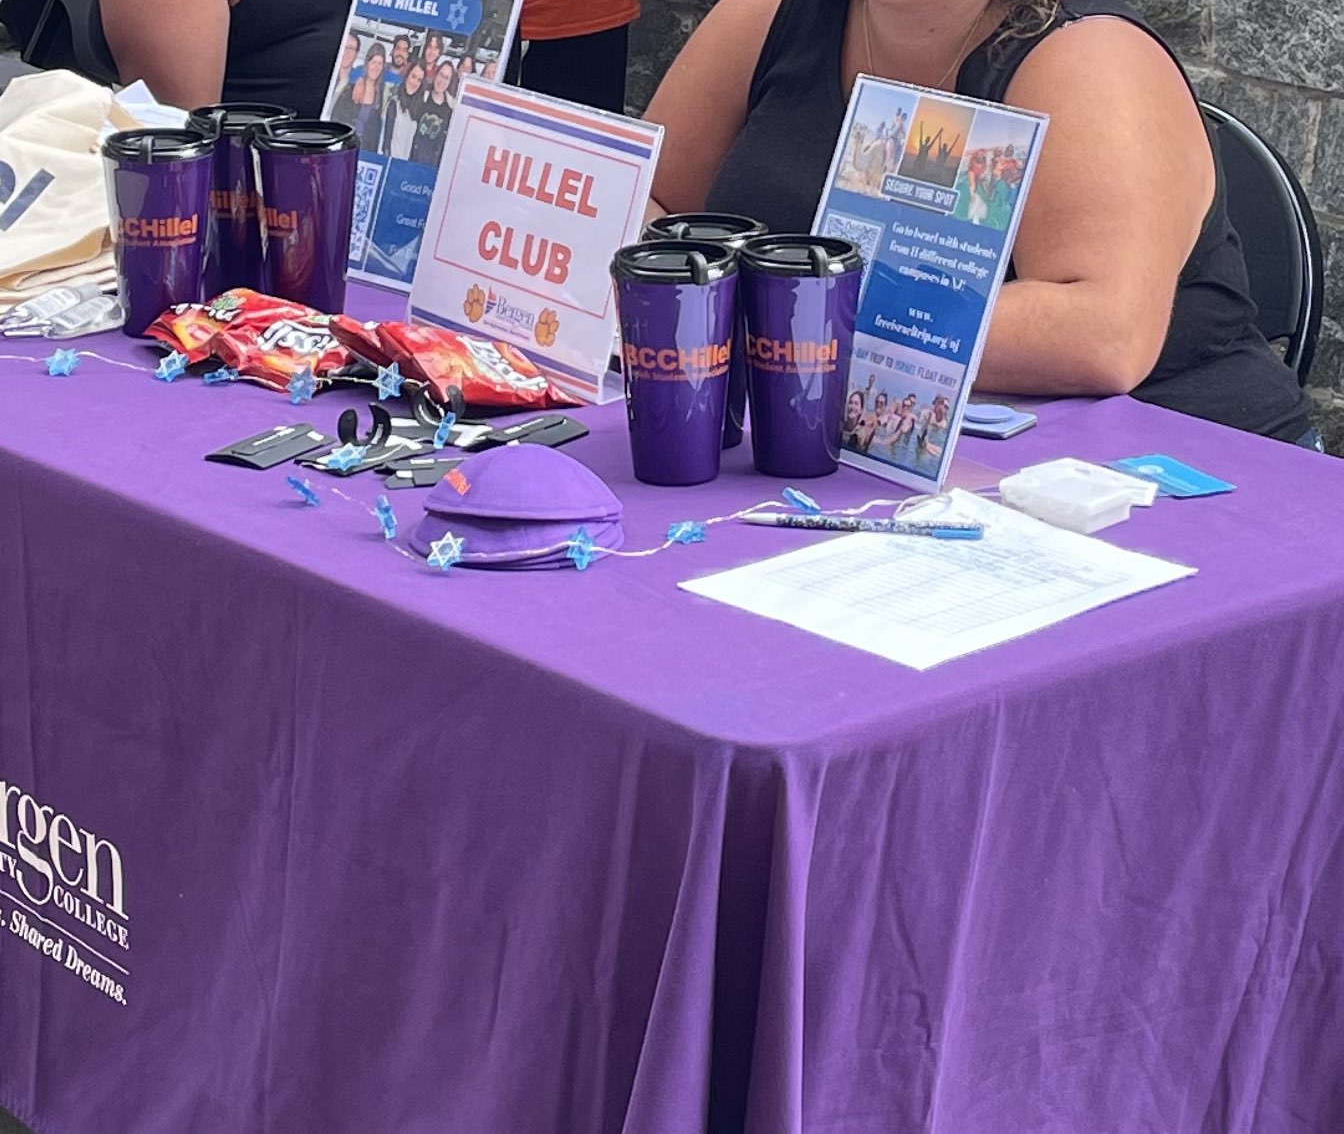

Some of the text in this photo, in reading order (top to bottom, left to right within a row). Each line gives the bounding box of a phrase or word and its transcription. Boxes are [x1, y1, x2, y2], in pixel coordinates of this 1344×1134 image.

[400, 181, 422, 194] Good
[481, 145, 598, 218] HILLEL
[934, 191, 955, 206] SPOT
[478, 220, 572, 285] CLUB
[889, 240, 910, 255] from
[918, 248, 958, 269] different
[957, 260, 990, 279] college
[939, 235, 959, 250] with
[959, 242, 997, 259] students
[496, 296, 535, 326] Bergen
[746, 333, 838, 363] CCHillel
[53, 885, 130, 951] COLLEGE
[9, 910, 62, 962] Shared
[64, 945, 128, 1007] Dreams.
